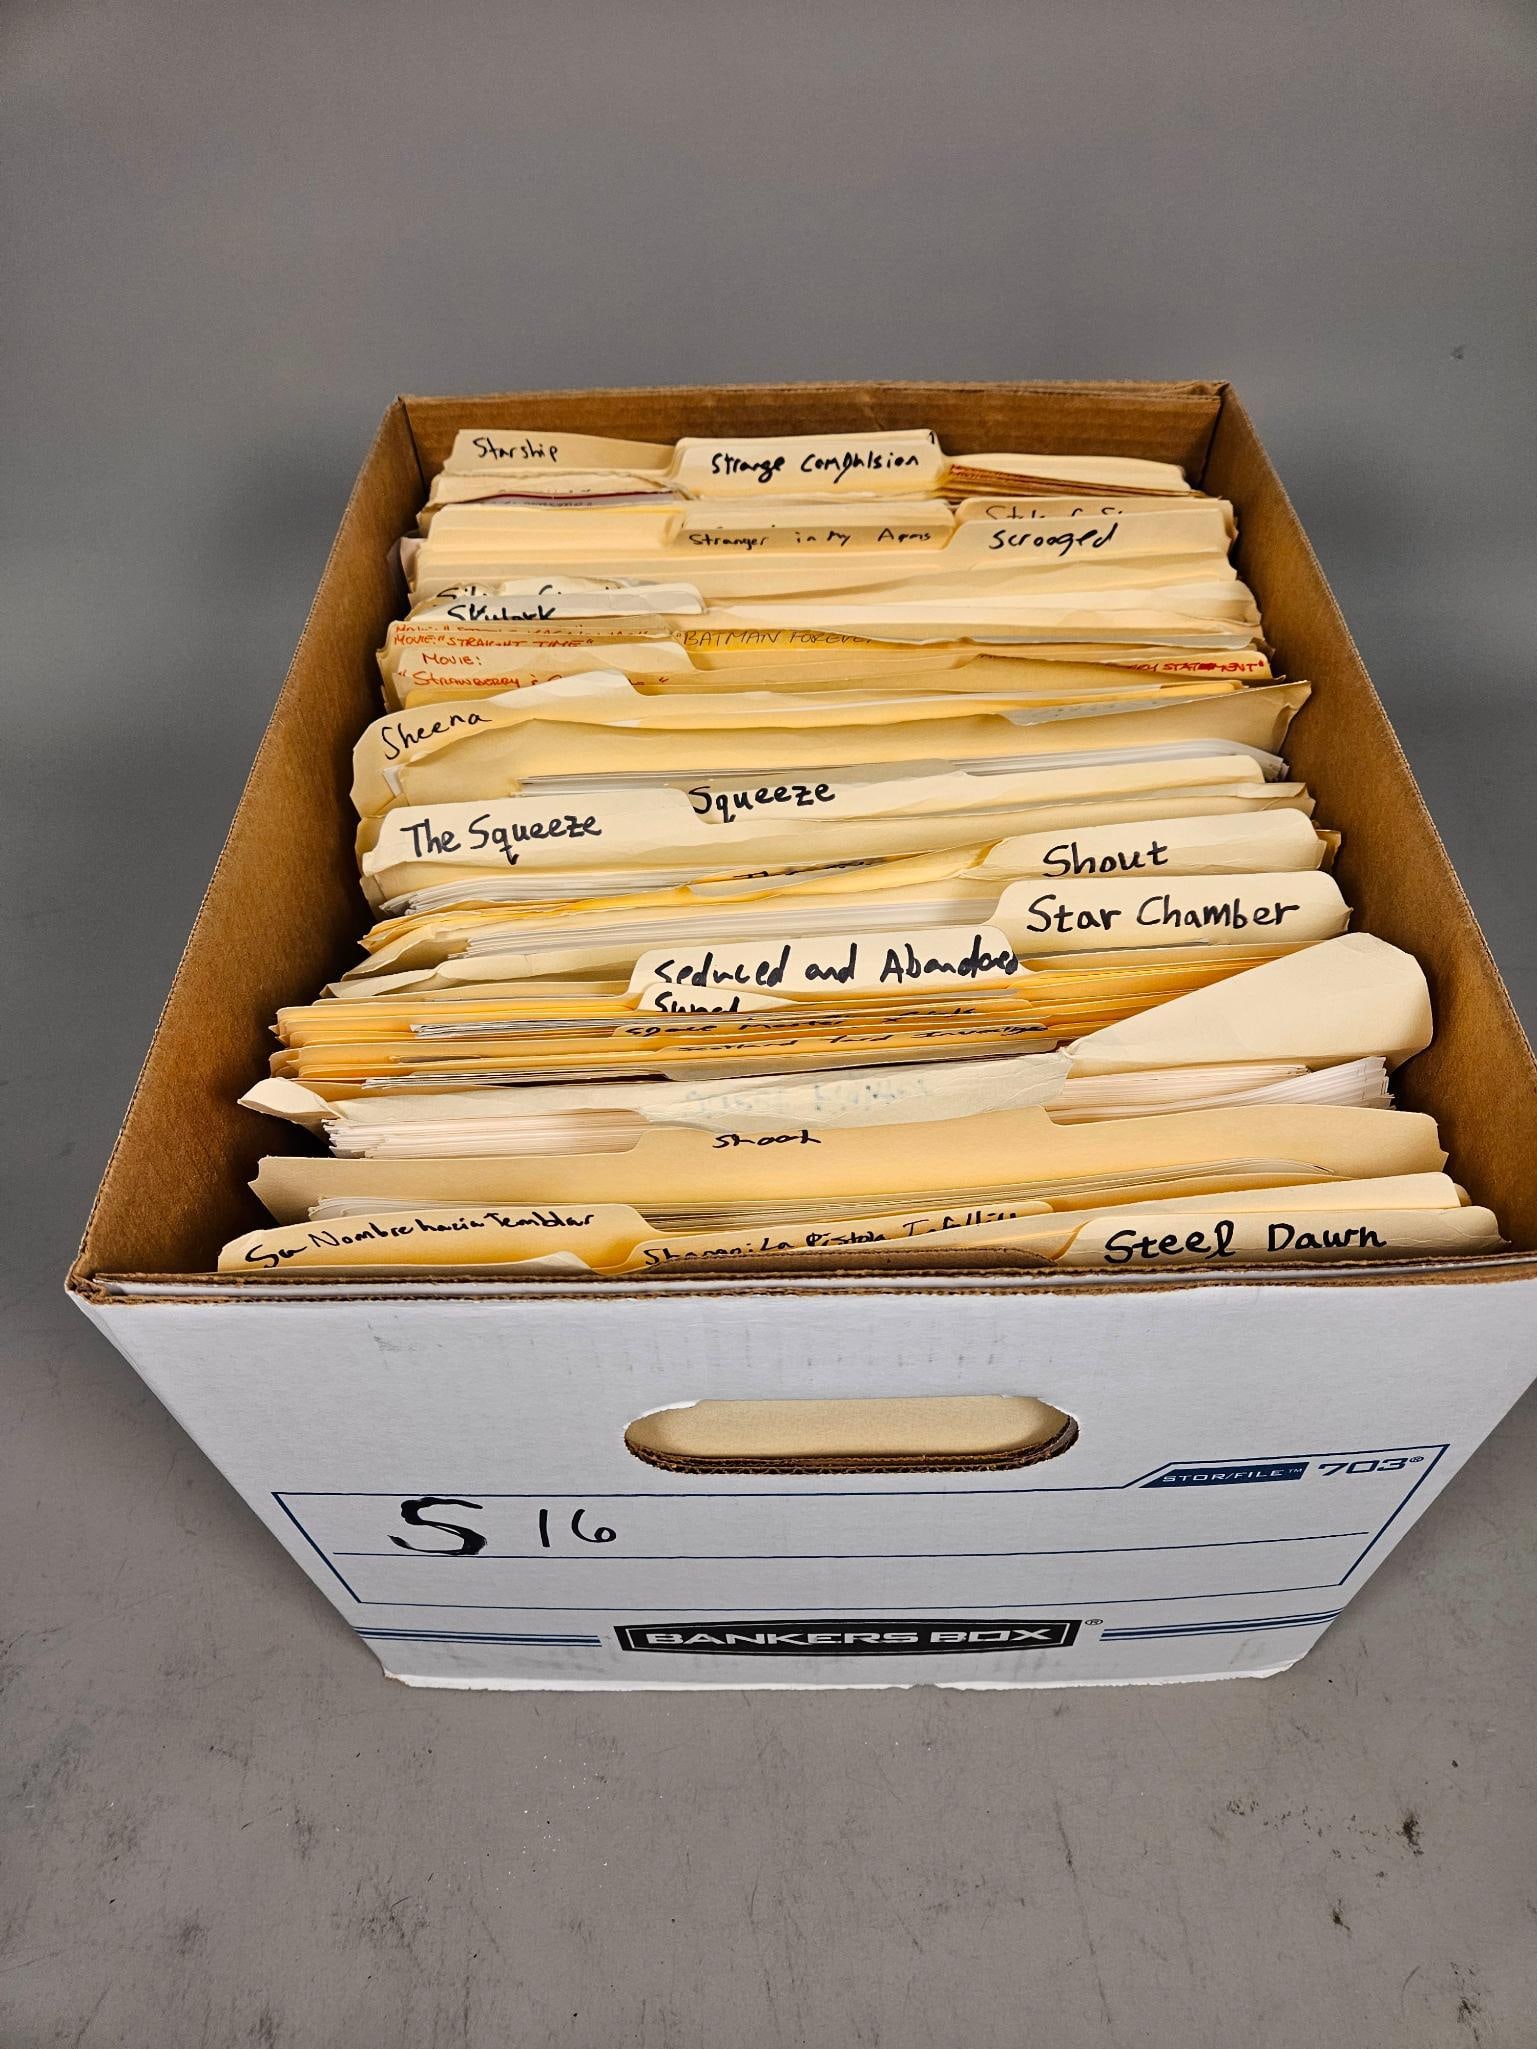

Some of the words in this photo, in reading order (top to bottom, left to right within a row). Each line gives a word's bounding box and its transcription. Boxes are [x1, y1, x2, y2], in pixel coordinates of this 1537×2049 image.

[473, 438, 559, 463] Starship
[711, 453, 786, 483] Strange
[800, 451, 919, 484] Compulsion
[688, 533, 769, 550] Stranger
[794, 531, 817, 543] in
[381, 712, 493, 761] Sheena
[689, 783, 836, 824] Squeeze
[400, 819, 461, 858] The
[468, 813, 603, 865] Squeeze
[1041, 840, 1169, 878] Shout
[1025, 894, 1122, 933] Star
[1136, 893, 1301, 930] Chamber
[804, 942, 858, 984] and
[308, 1221, 414, 1249] Nombre
[1103, 1220, 1237, 1265] Steel
[1267, 1222, 1388, 1254] Dawn
[387, 1496, 489, 1556] S
[537, 1508, 618, 1549] 16
[645, 1630, 920, 1647] BANKERS
[929, 1626, 1057, 1644] BOX
